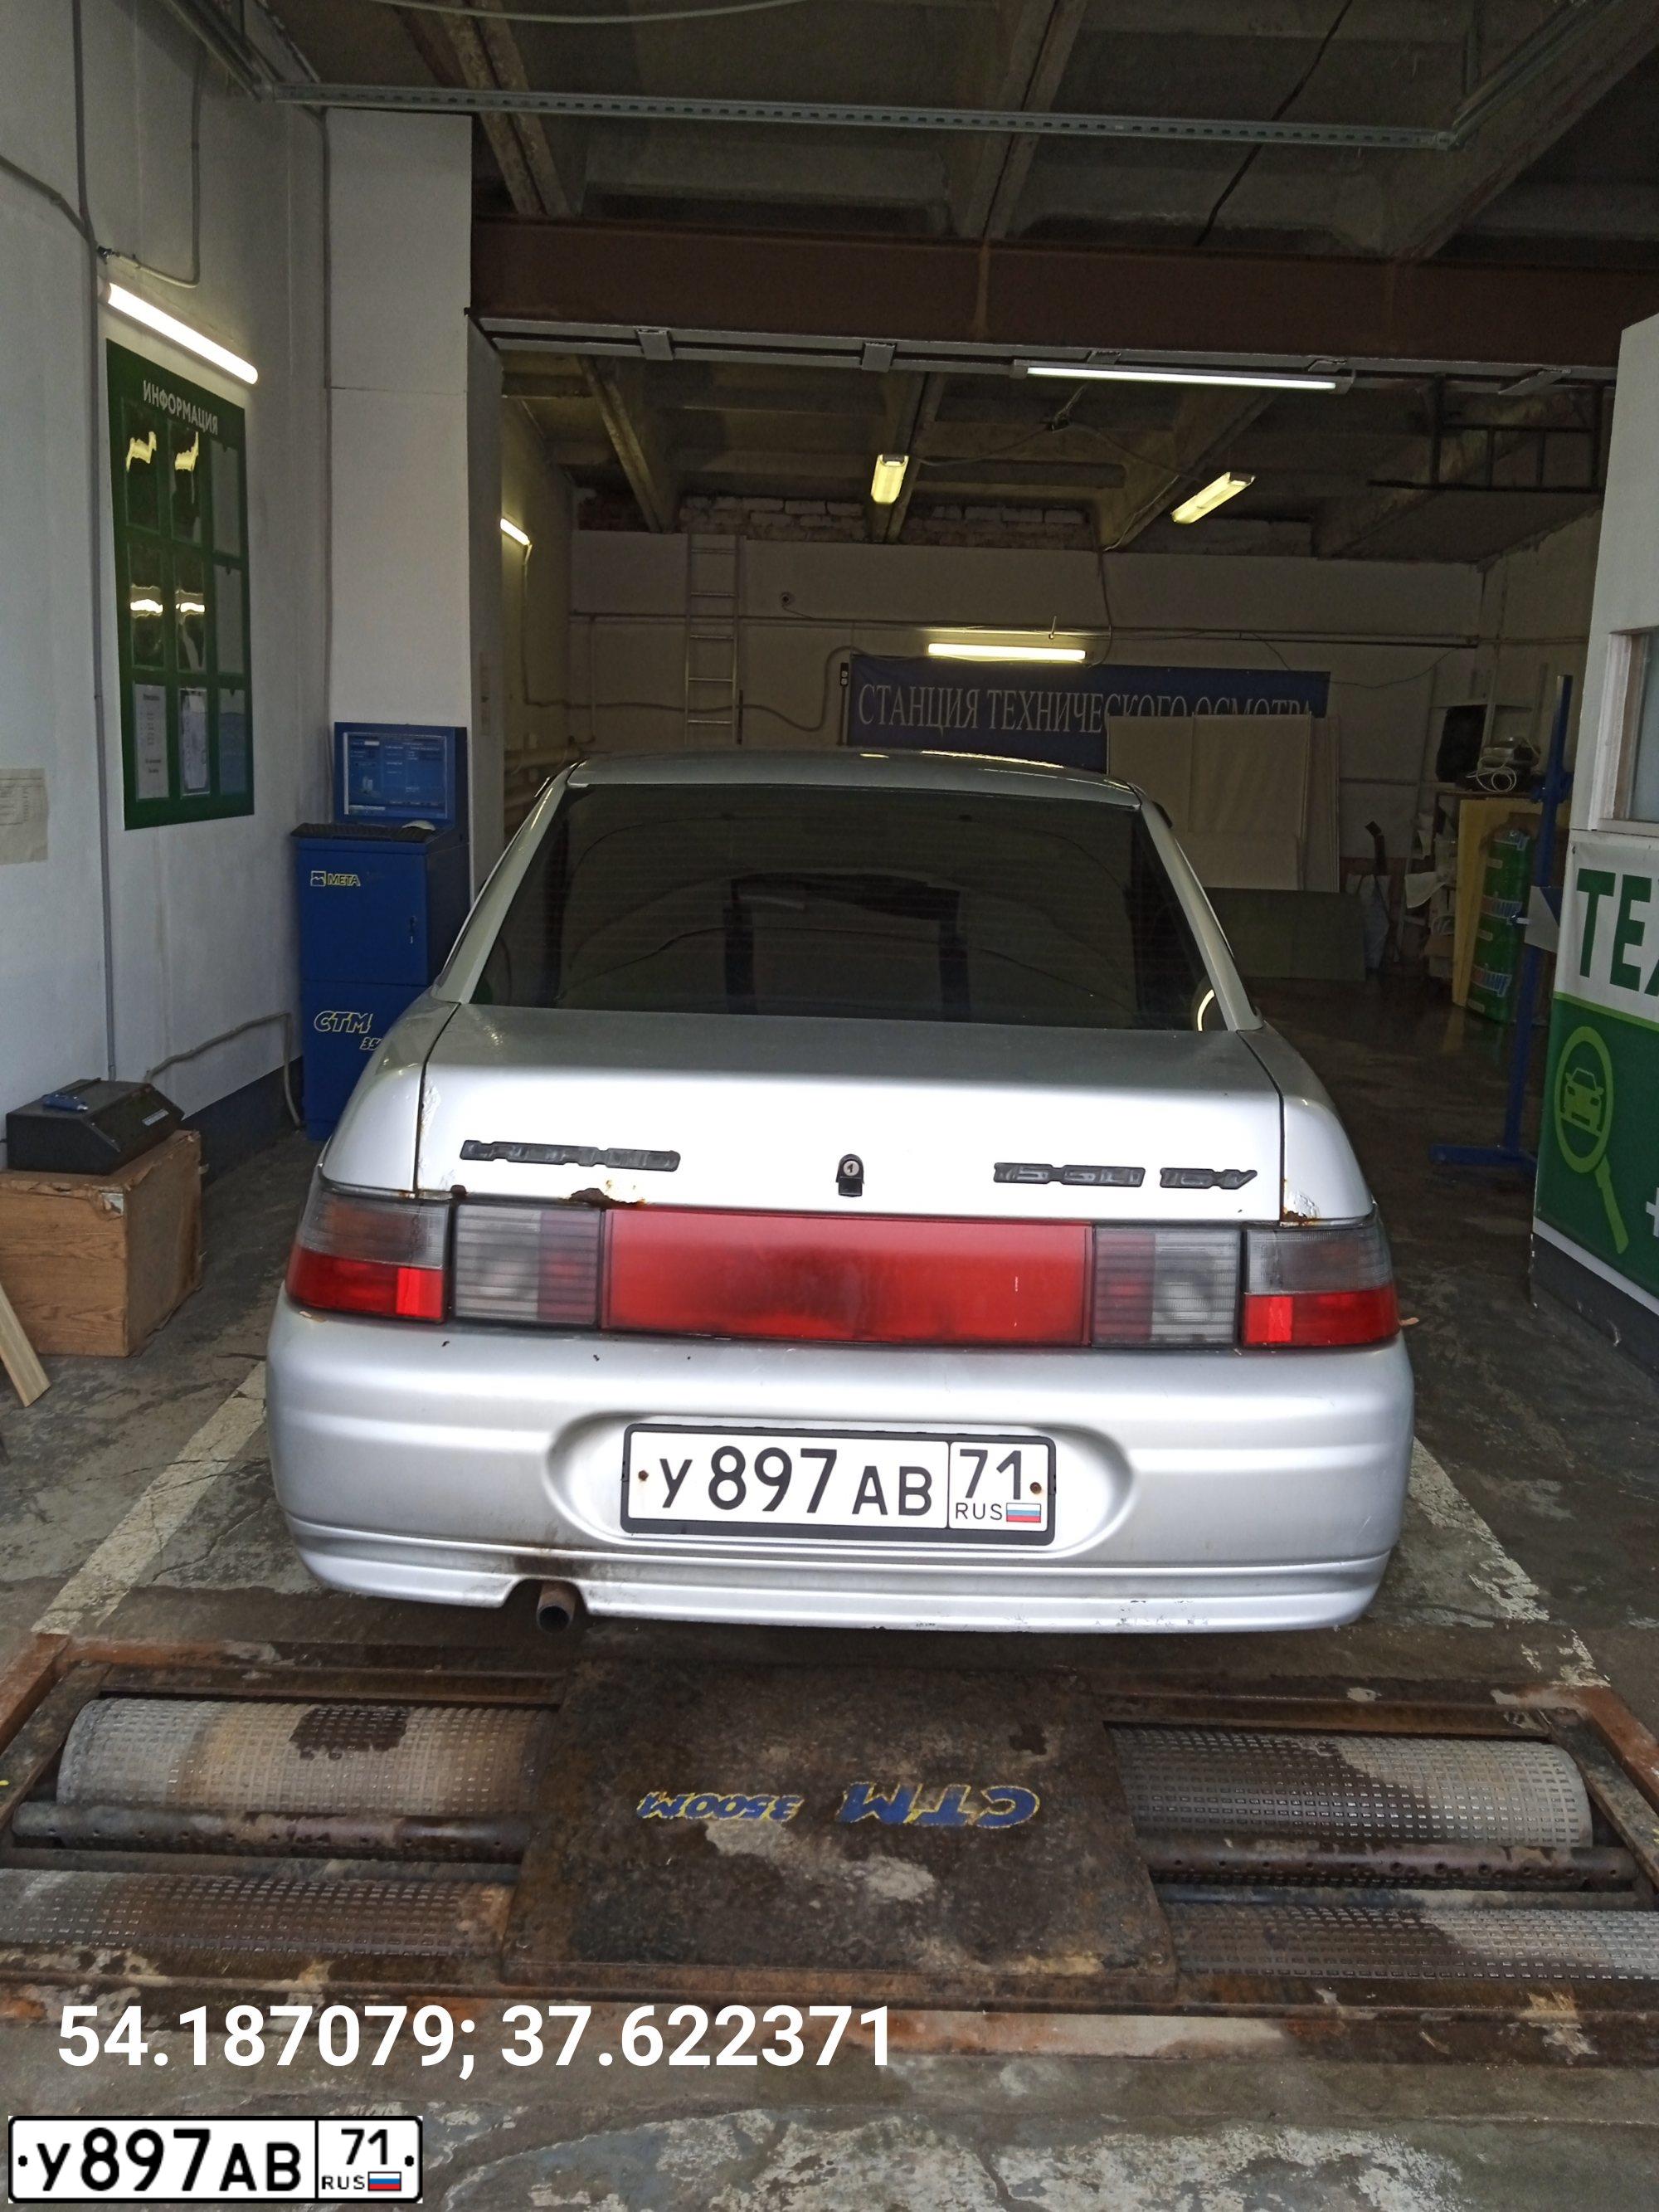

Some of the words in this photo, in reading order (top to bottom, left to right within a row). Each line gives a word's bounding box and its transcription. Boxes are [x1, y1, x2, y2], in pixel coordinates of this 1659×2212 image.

[143, 379, 218, 436] ИНФОРМАЦИЯ
[858, 683, 980, 737] СТАНЦИЯ
[1576, 867, 1659, 996] ТЕ
[959, 1449, 1022, 1501] 71
[955, 1502, 1003, 1522] RUS
